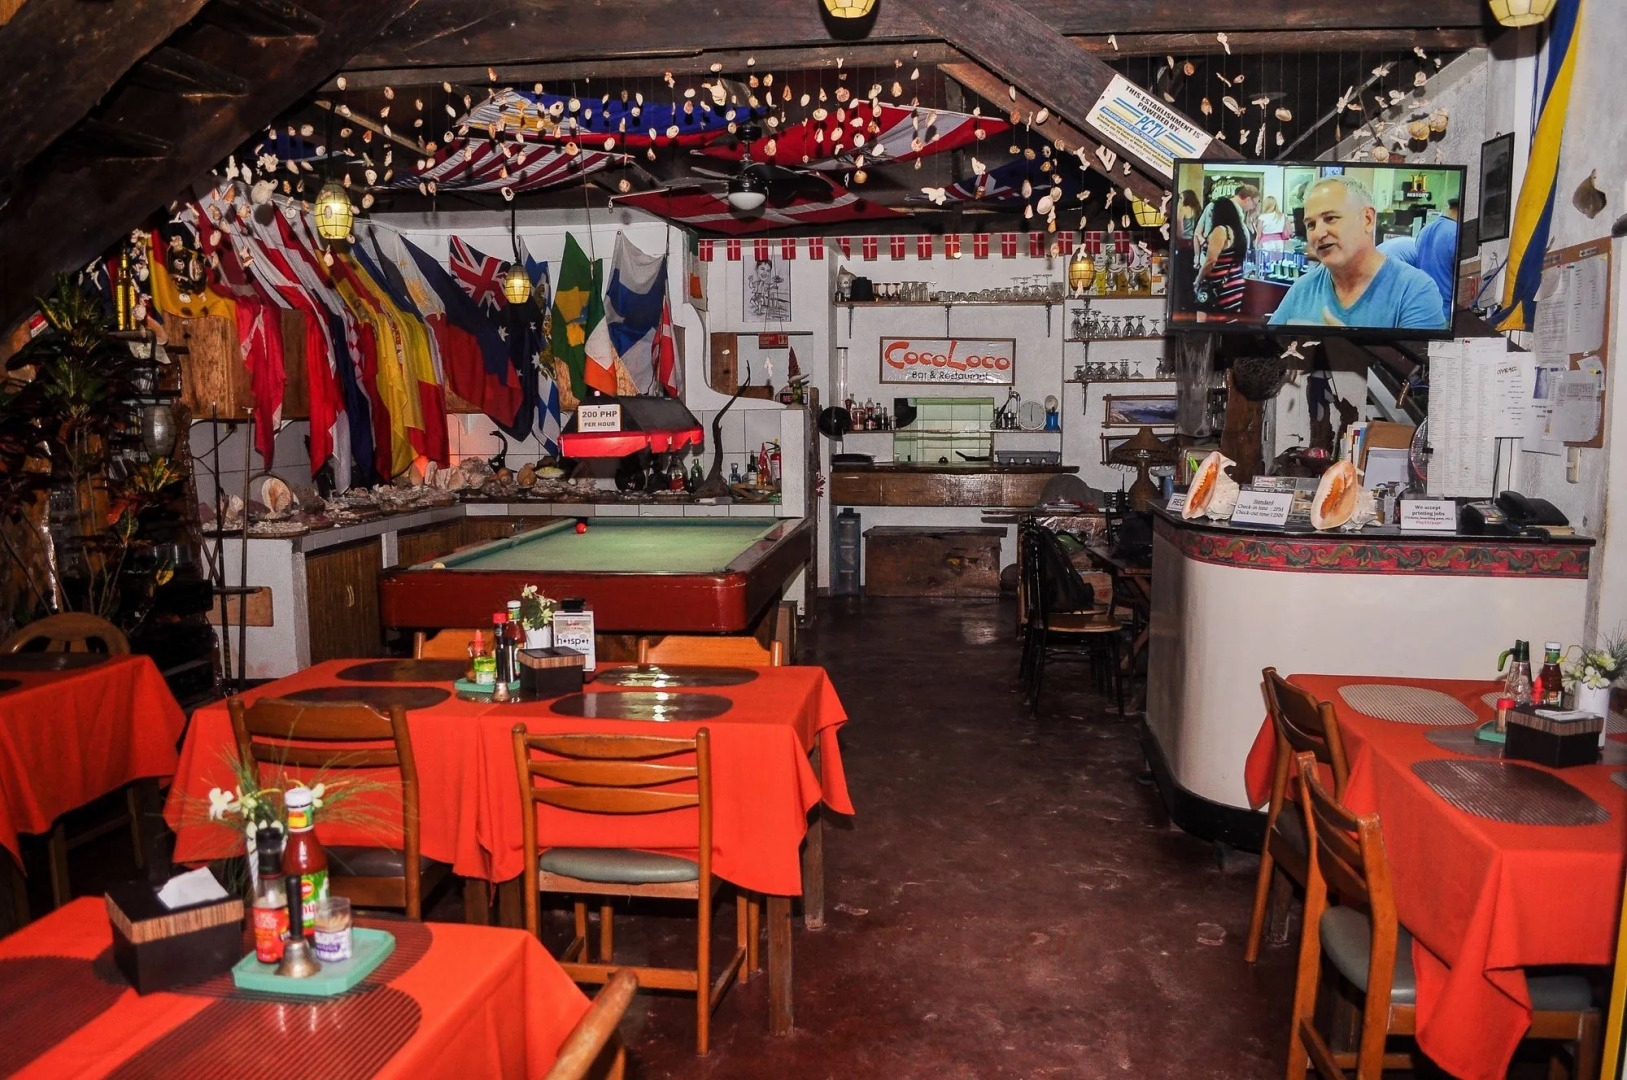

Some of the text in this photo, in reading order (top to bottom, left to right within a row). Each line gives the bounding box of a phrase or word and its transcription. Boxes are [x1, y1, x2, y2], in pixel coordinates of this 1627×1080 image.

[1124, 85, 1201, 139] THIS ESTABLISHMENT IS
[1137, 102, 1182, 134] POWERED BY:
[1136, 116, 1168, 139] PCTV
[912, 371, 988, 380] Bar & Restaurant
